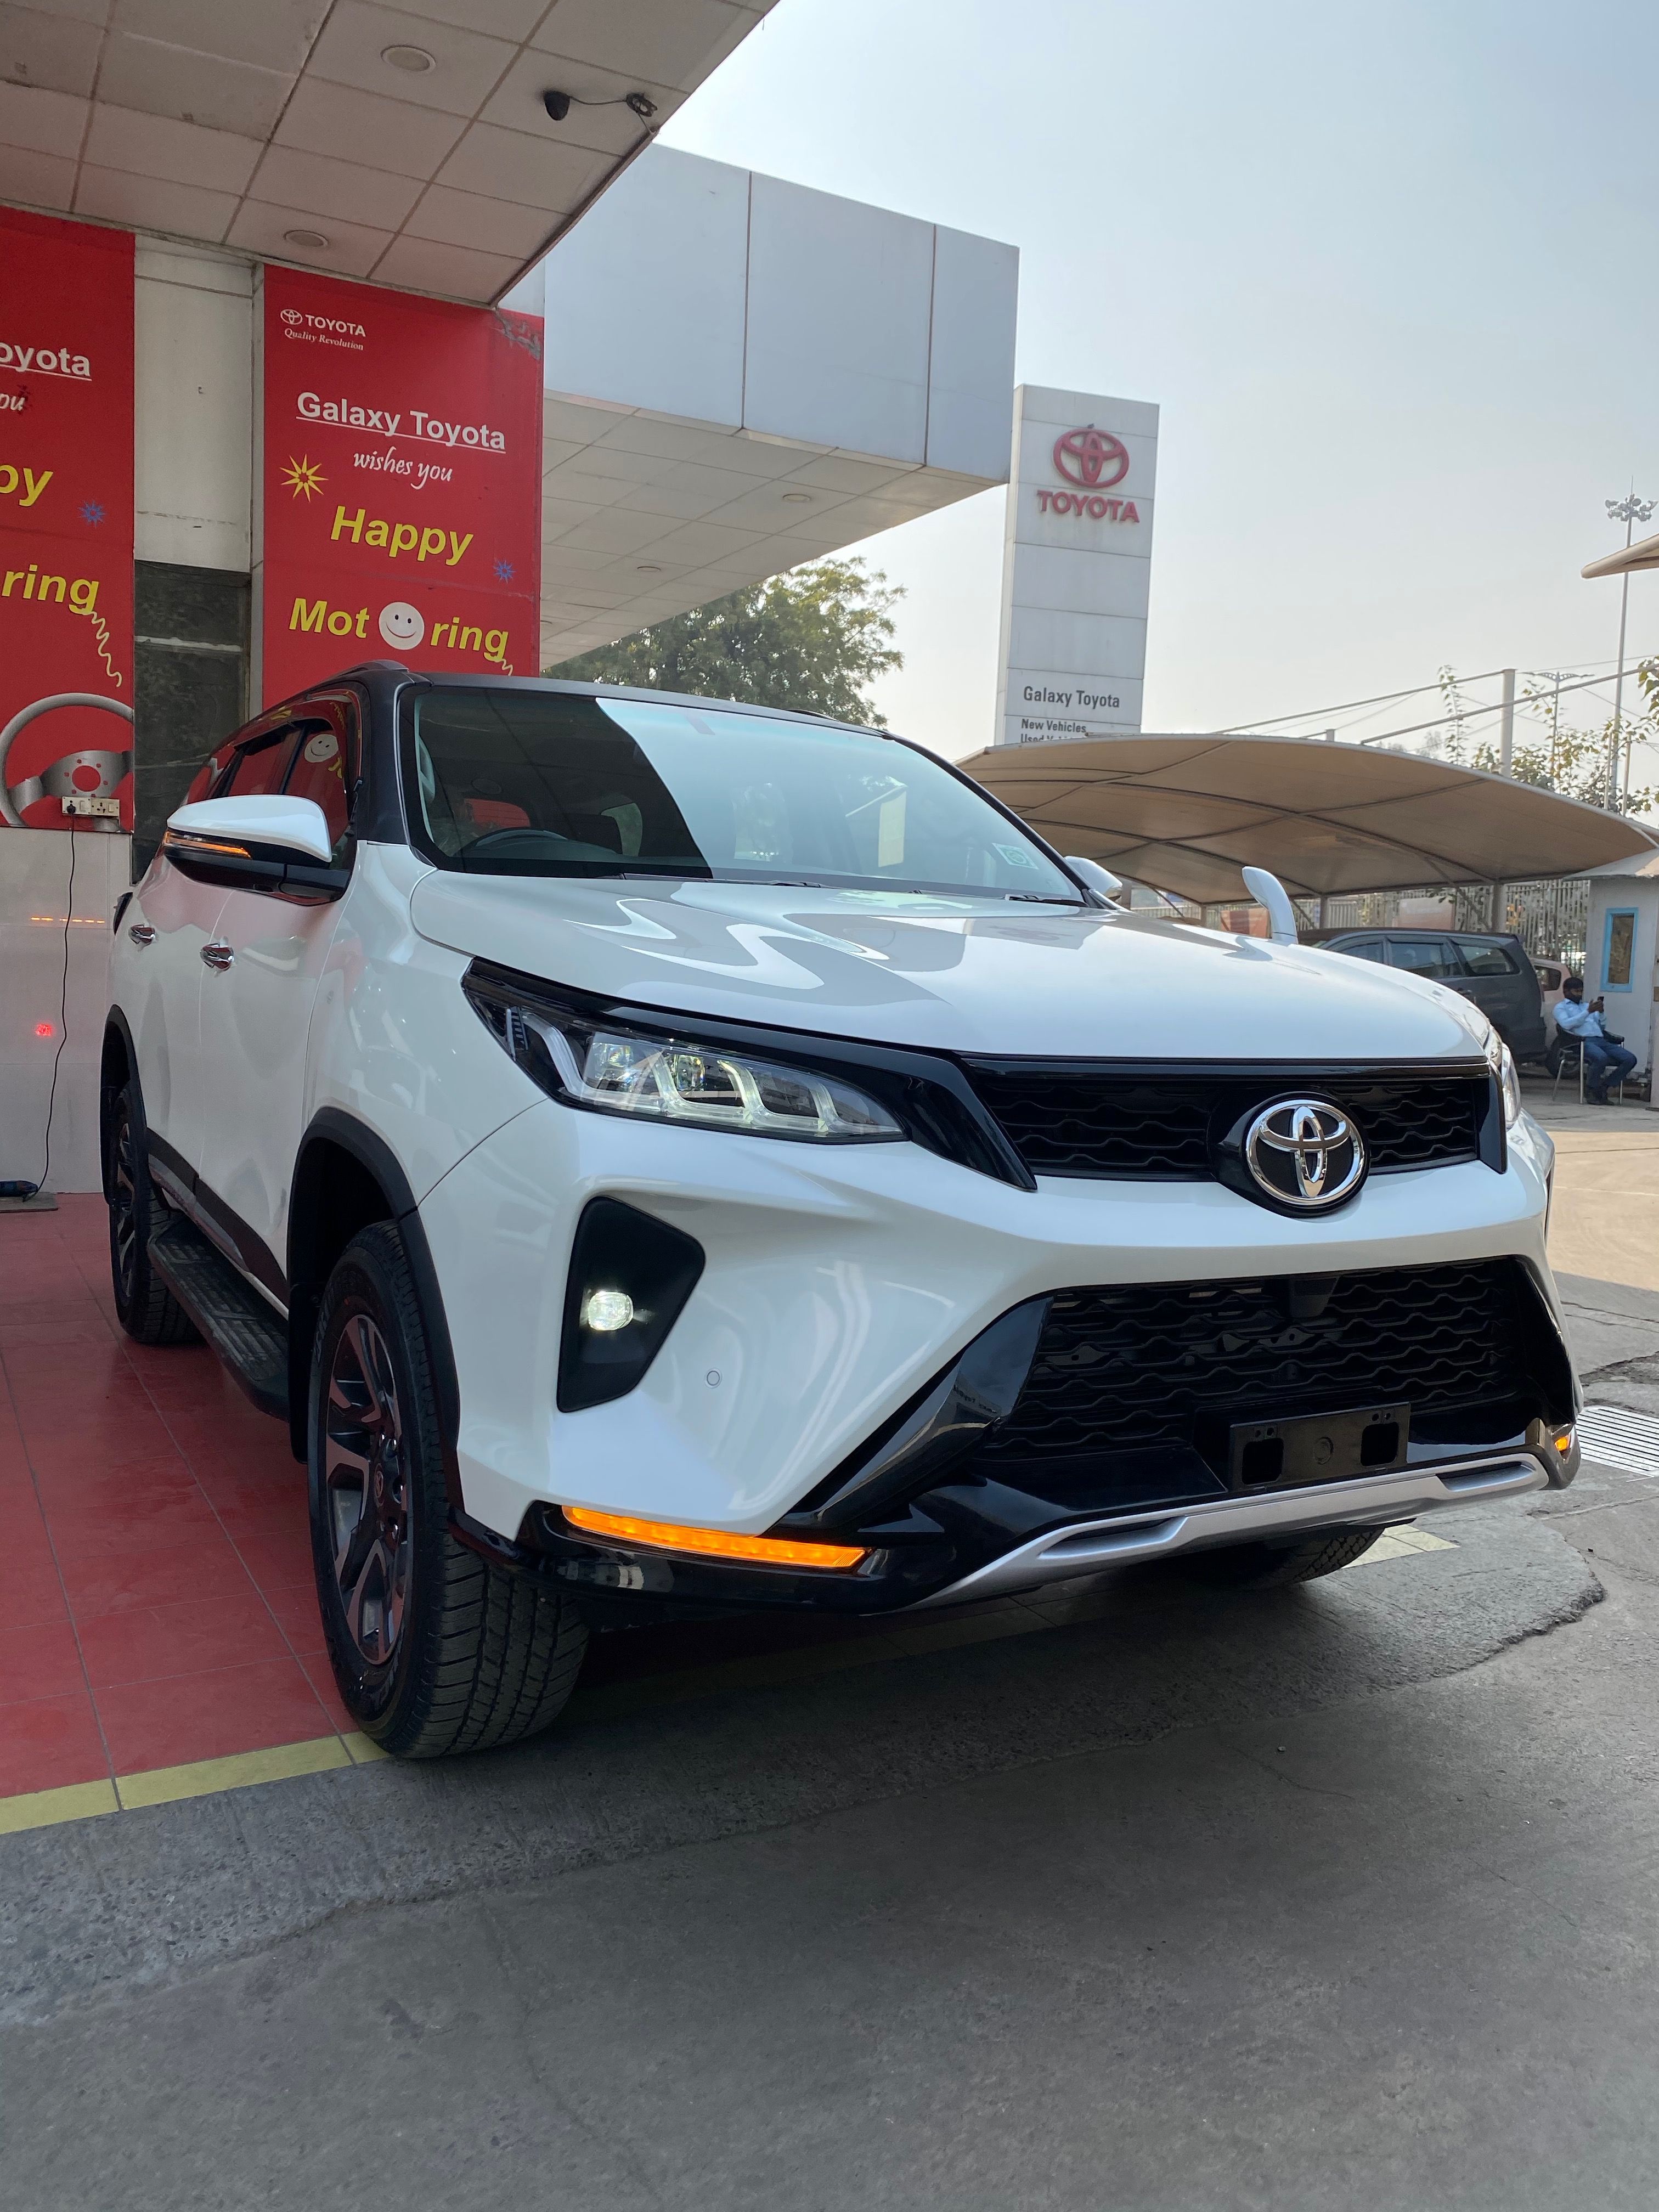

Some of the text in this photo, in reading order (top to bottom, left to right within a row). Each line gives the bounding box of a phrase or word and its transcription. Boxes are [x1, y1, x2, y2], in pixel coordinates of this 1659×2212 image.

[284, 328, 364, 351] Quality Revolution
[305, 314, 366, 337] TOYOTA
[0, 342, 91, 376] oyota
[297, 392, 505, 450] Galaxy Toyota
[353, 445, 453, 490] wishes you
[1037, 490, 1140, 523] TOYOTA
[330, 505, 474, 566] Happy
[2, 564, 99, 615] ring
[289, 598, 509, 662] Mot ring
[1024, 686, 1120, 709] Galaxy Toyota
[1022, 719, 1086, 733] New Vehicles
